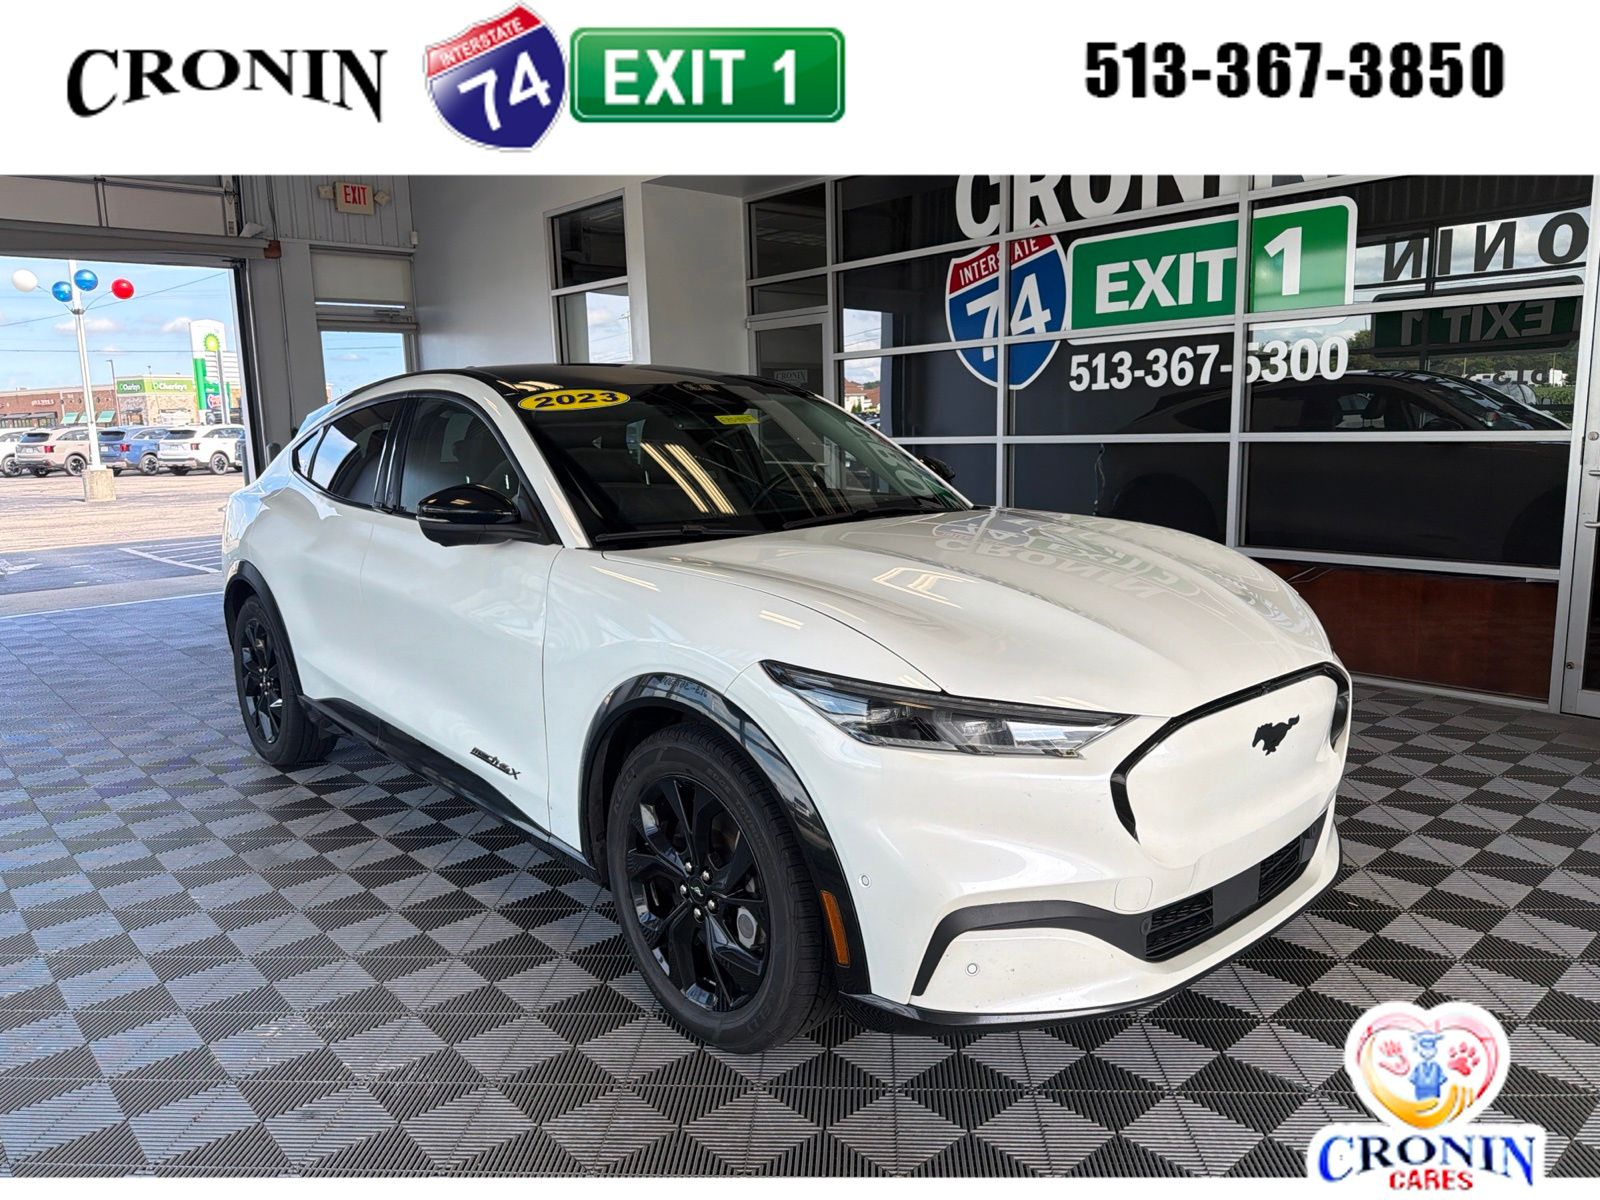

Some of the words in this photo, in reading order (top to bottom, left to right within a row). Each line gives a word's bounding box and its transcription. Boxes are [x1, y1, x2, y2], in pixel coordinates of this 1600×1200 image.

[343, 185, 367, 205] EXIT
[955, 174, 1340, 239] CRO
[959, 237, 1040, 286] INTERATE
[1095, 246, 1238, 314] EXIT
[1263, 226, 1303, 296] 1
[966, 272, 1052, 362] 74
[1068, 336, 1350, 392] 513-367-5300
[534, 391, 620, 410] 2023
